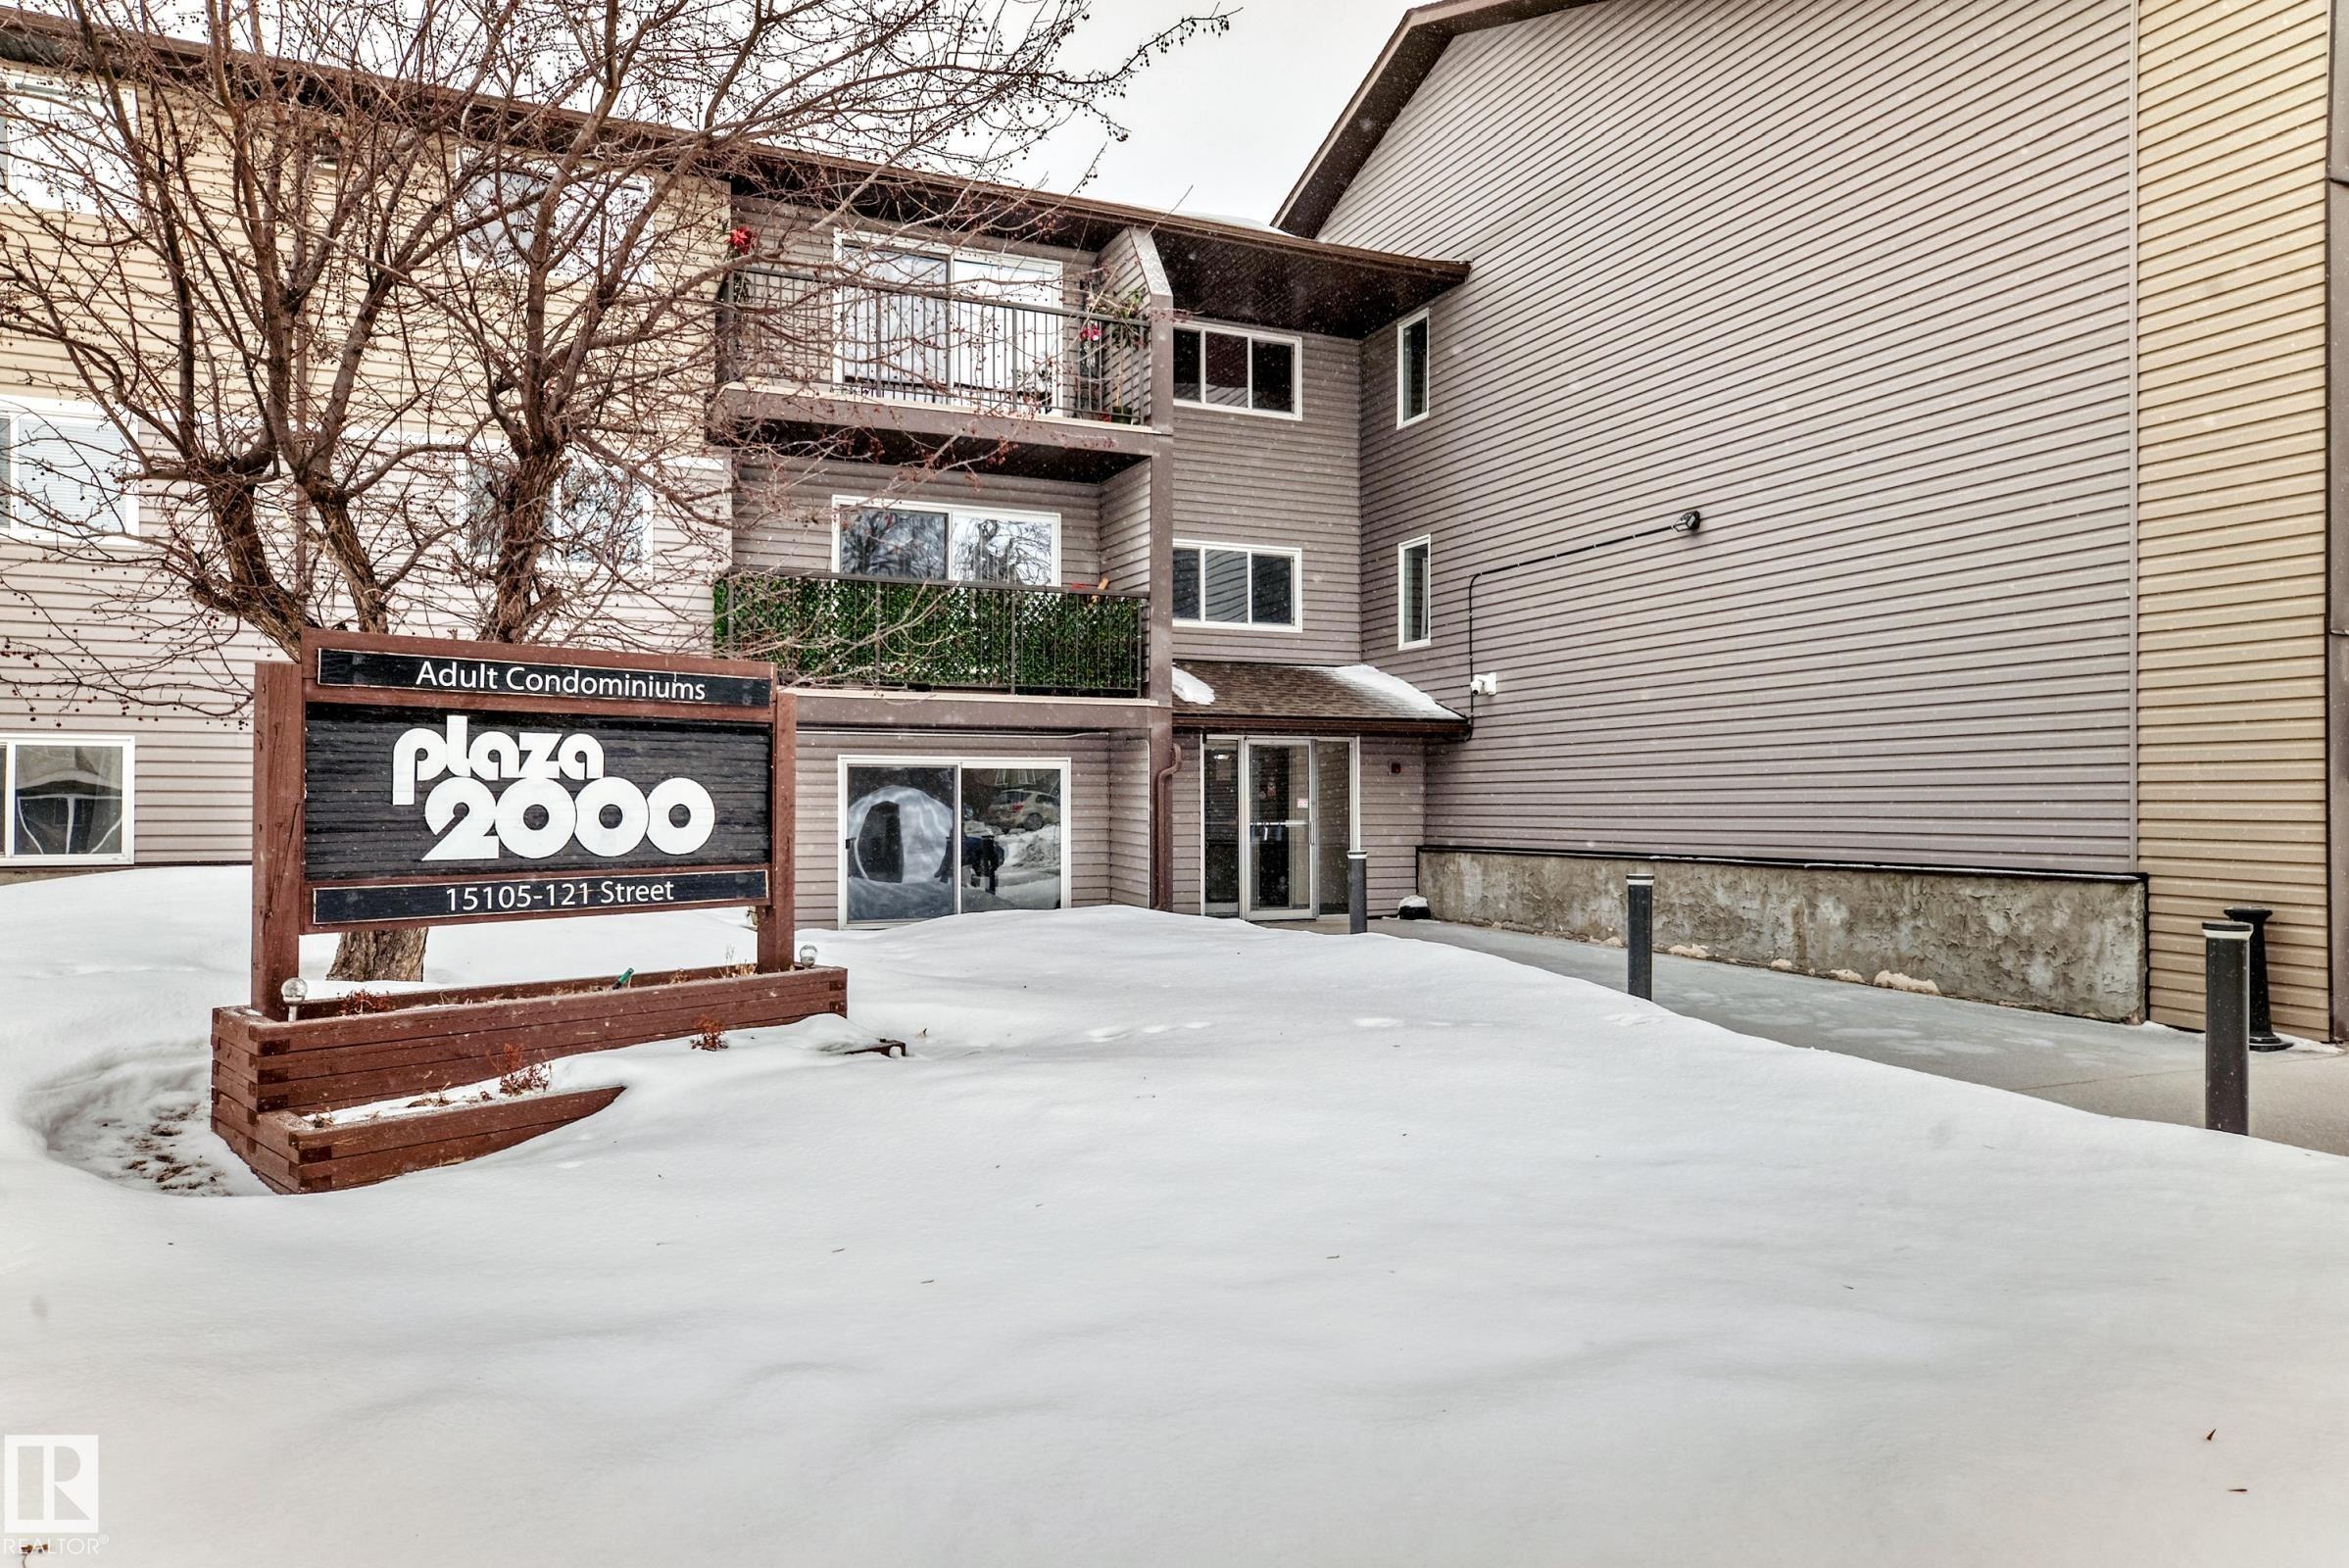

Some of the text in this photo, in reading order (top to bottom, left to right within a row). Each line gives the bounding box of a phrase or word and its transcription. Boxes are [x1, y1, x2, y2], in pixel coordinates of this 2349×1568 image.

[416, 661, 707, 701] Adult Condominiums
[393, 714, 605, 806] plaza
[421, 776, 715, 860] 2000
[446, 880, 674, 911] 15105-121 Street
